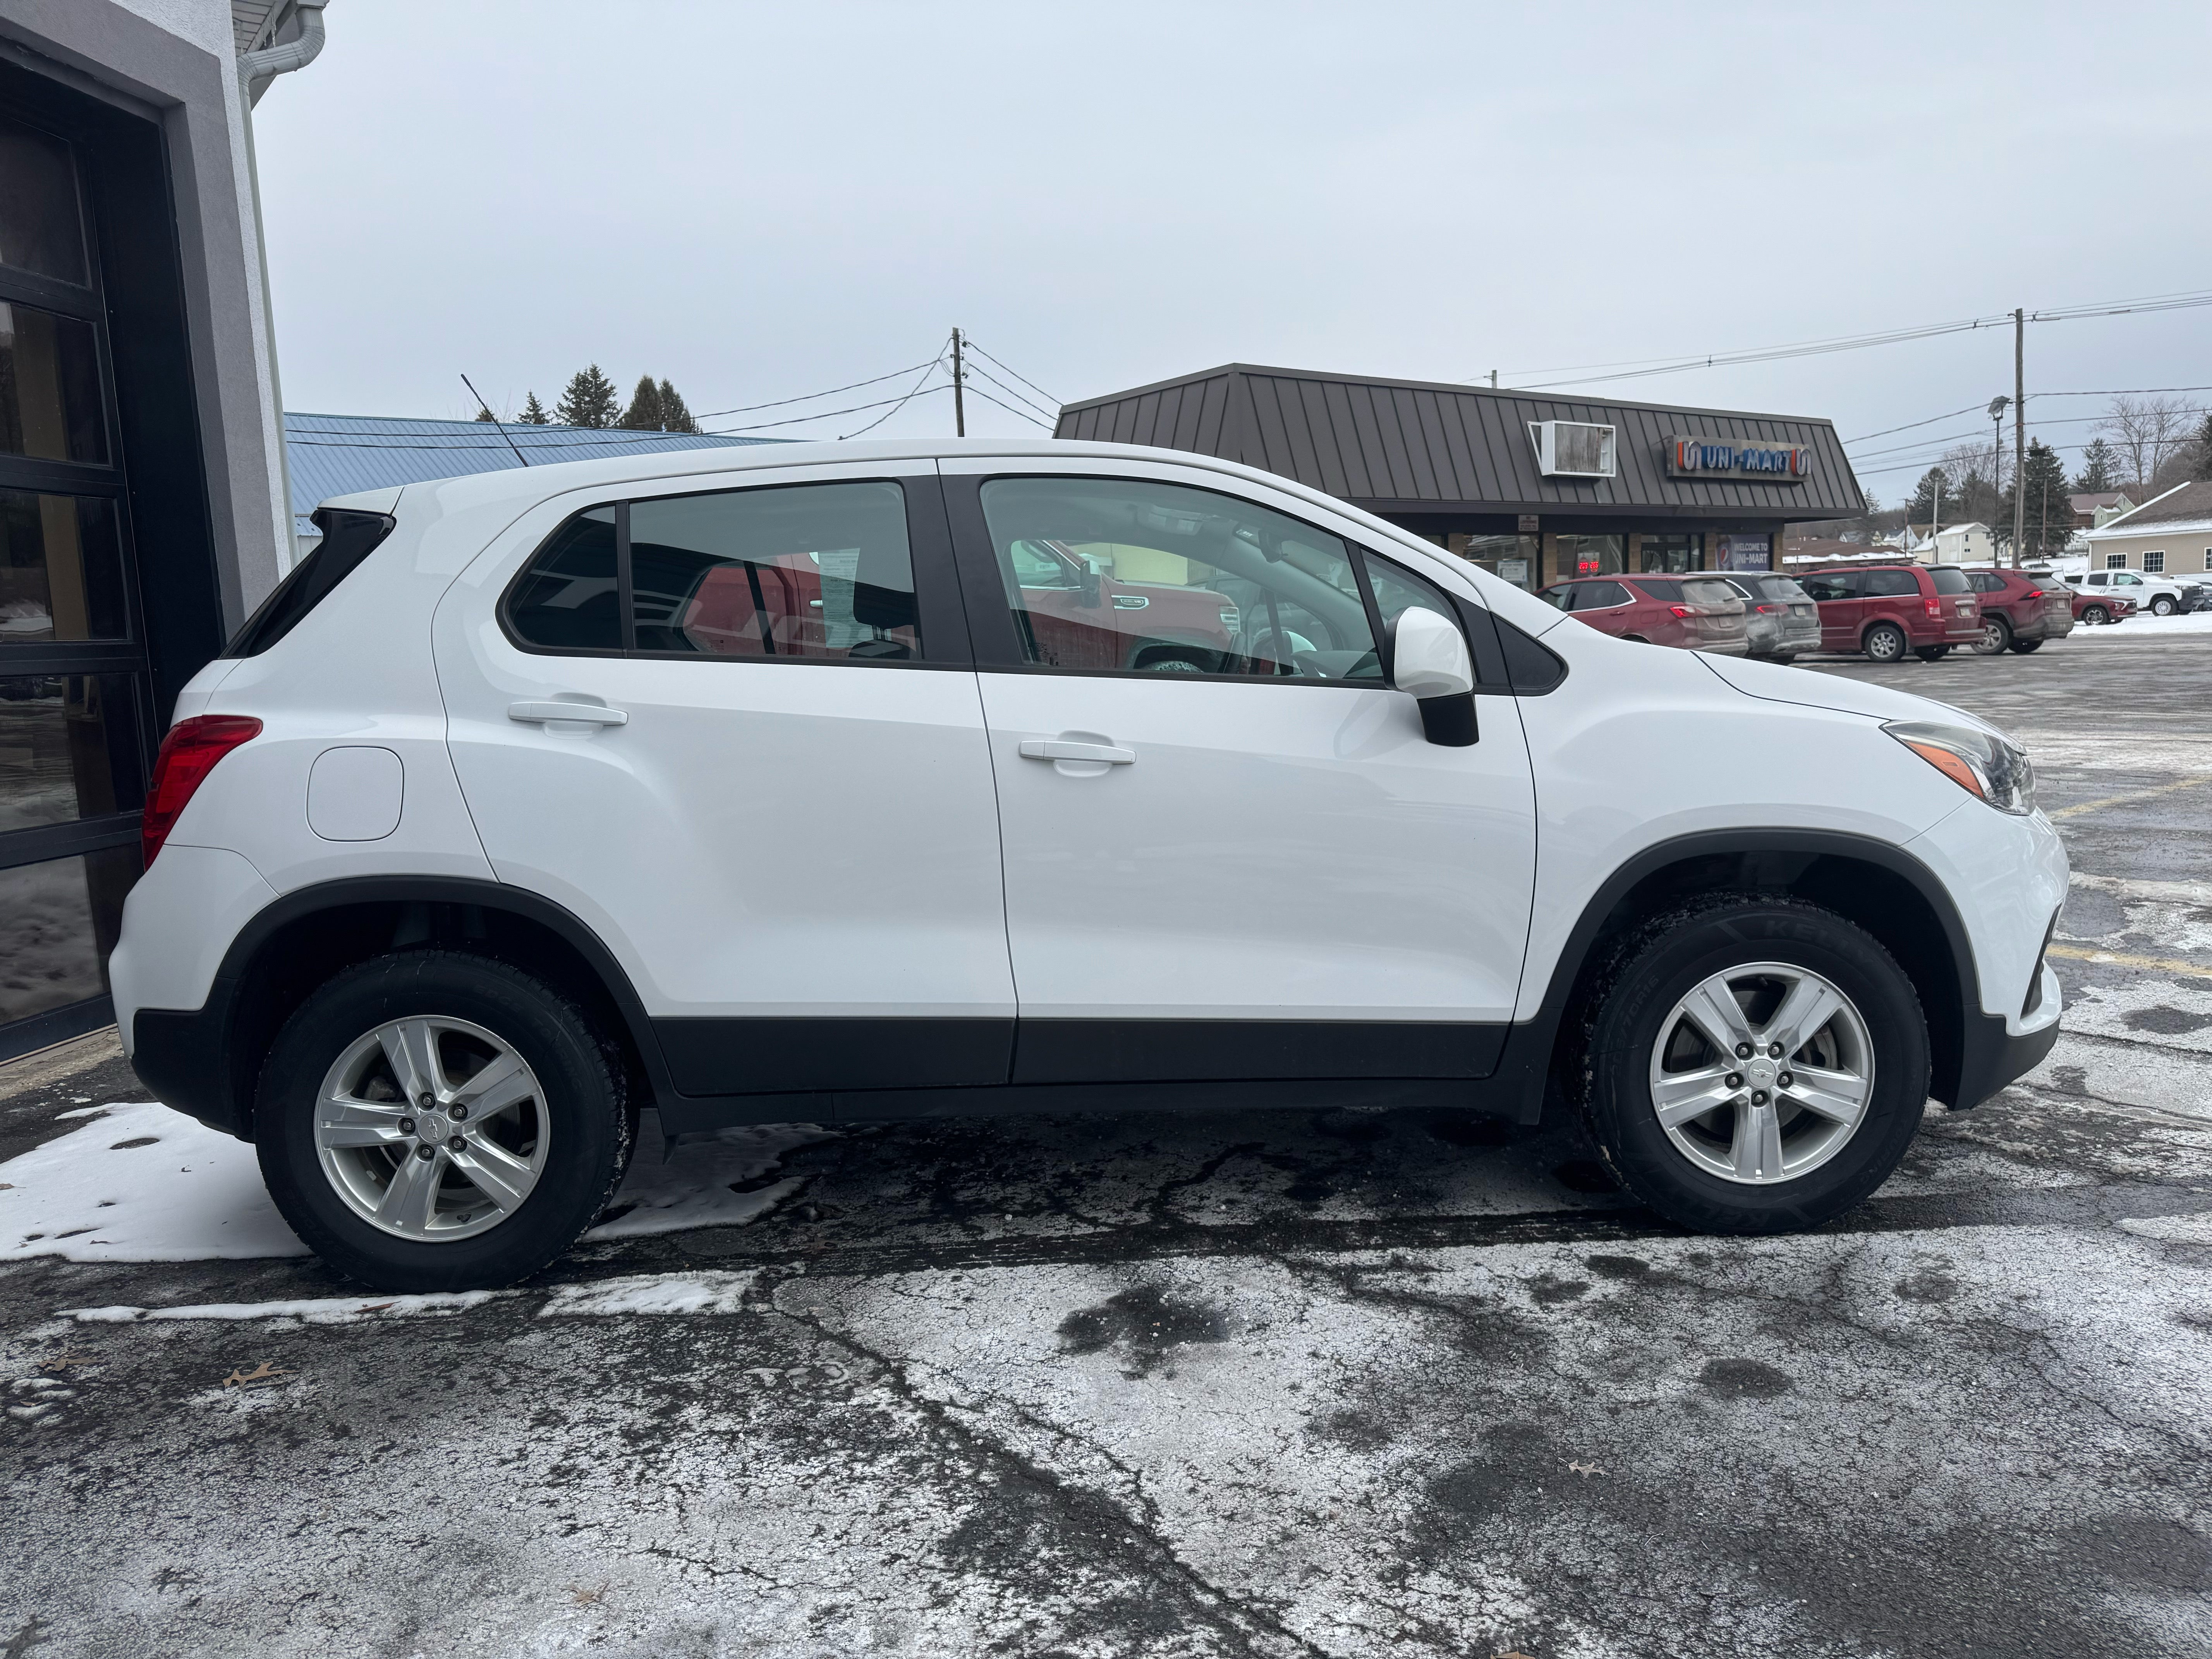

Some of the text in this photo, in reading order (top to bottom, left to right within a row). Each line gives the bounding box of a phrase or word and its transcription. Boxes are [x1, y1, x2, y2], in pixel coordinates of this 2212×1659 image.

[1702, 446, 1791, 471] UNI-MART
[1733, 553, 1768, 564] UNI-MART
[1734, 543, 1768, 551] WELCOME TO
[1763, 919, 1875, 967] KELLY
[473, 984, 524, 1013] EDGE
[534, 1017, 583, 1090] TOURING
[1609, 974, 1660, 1077] 205/70R16
